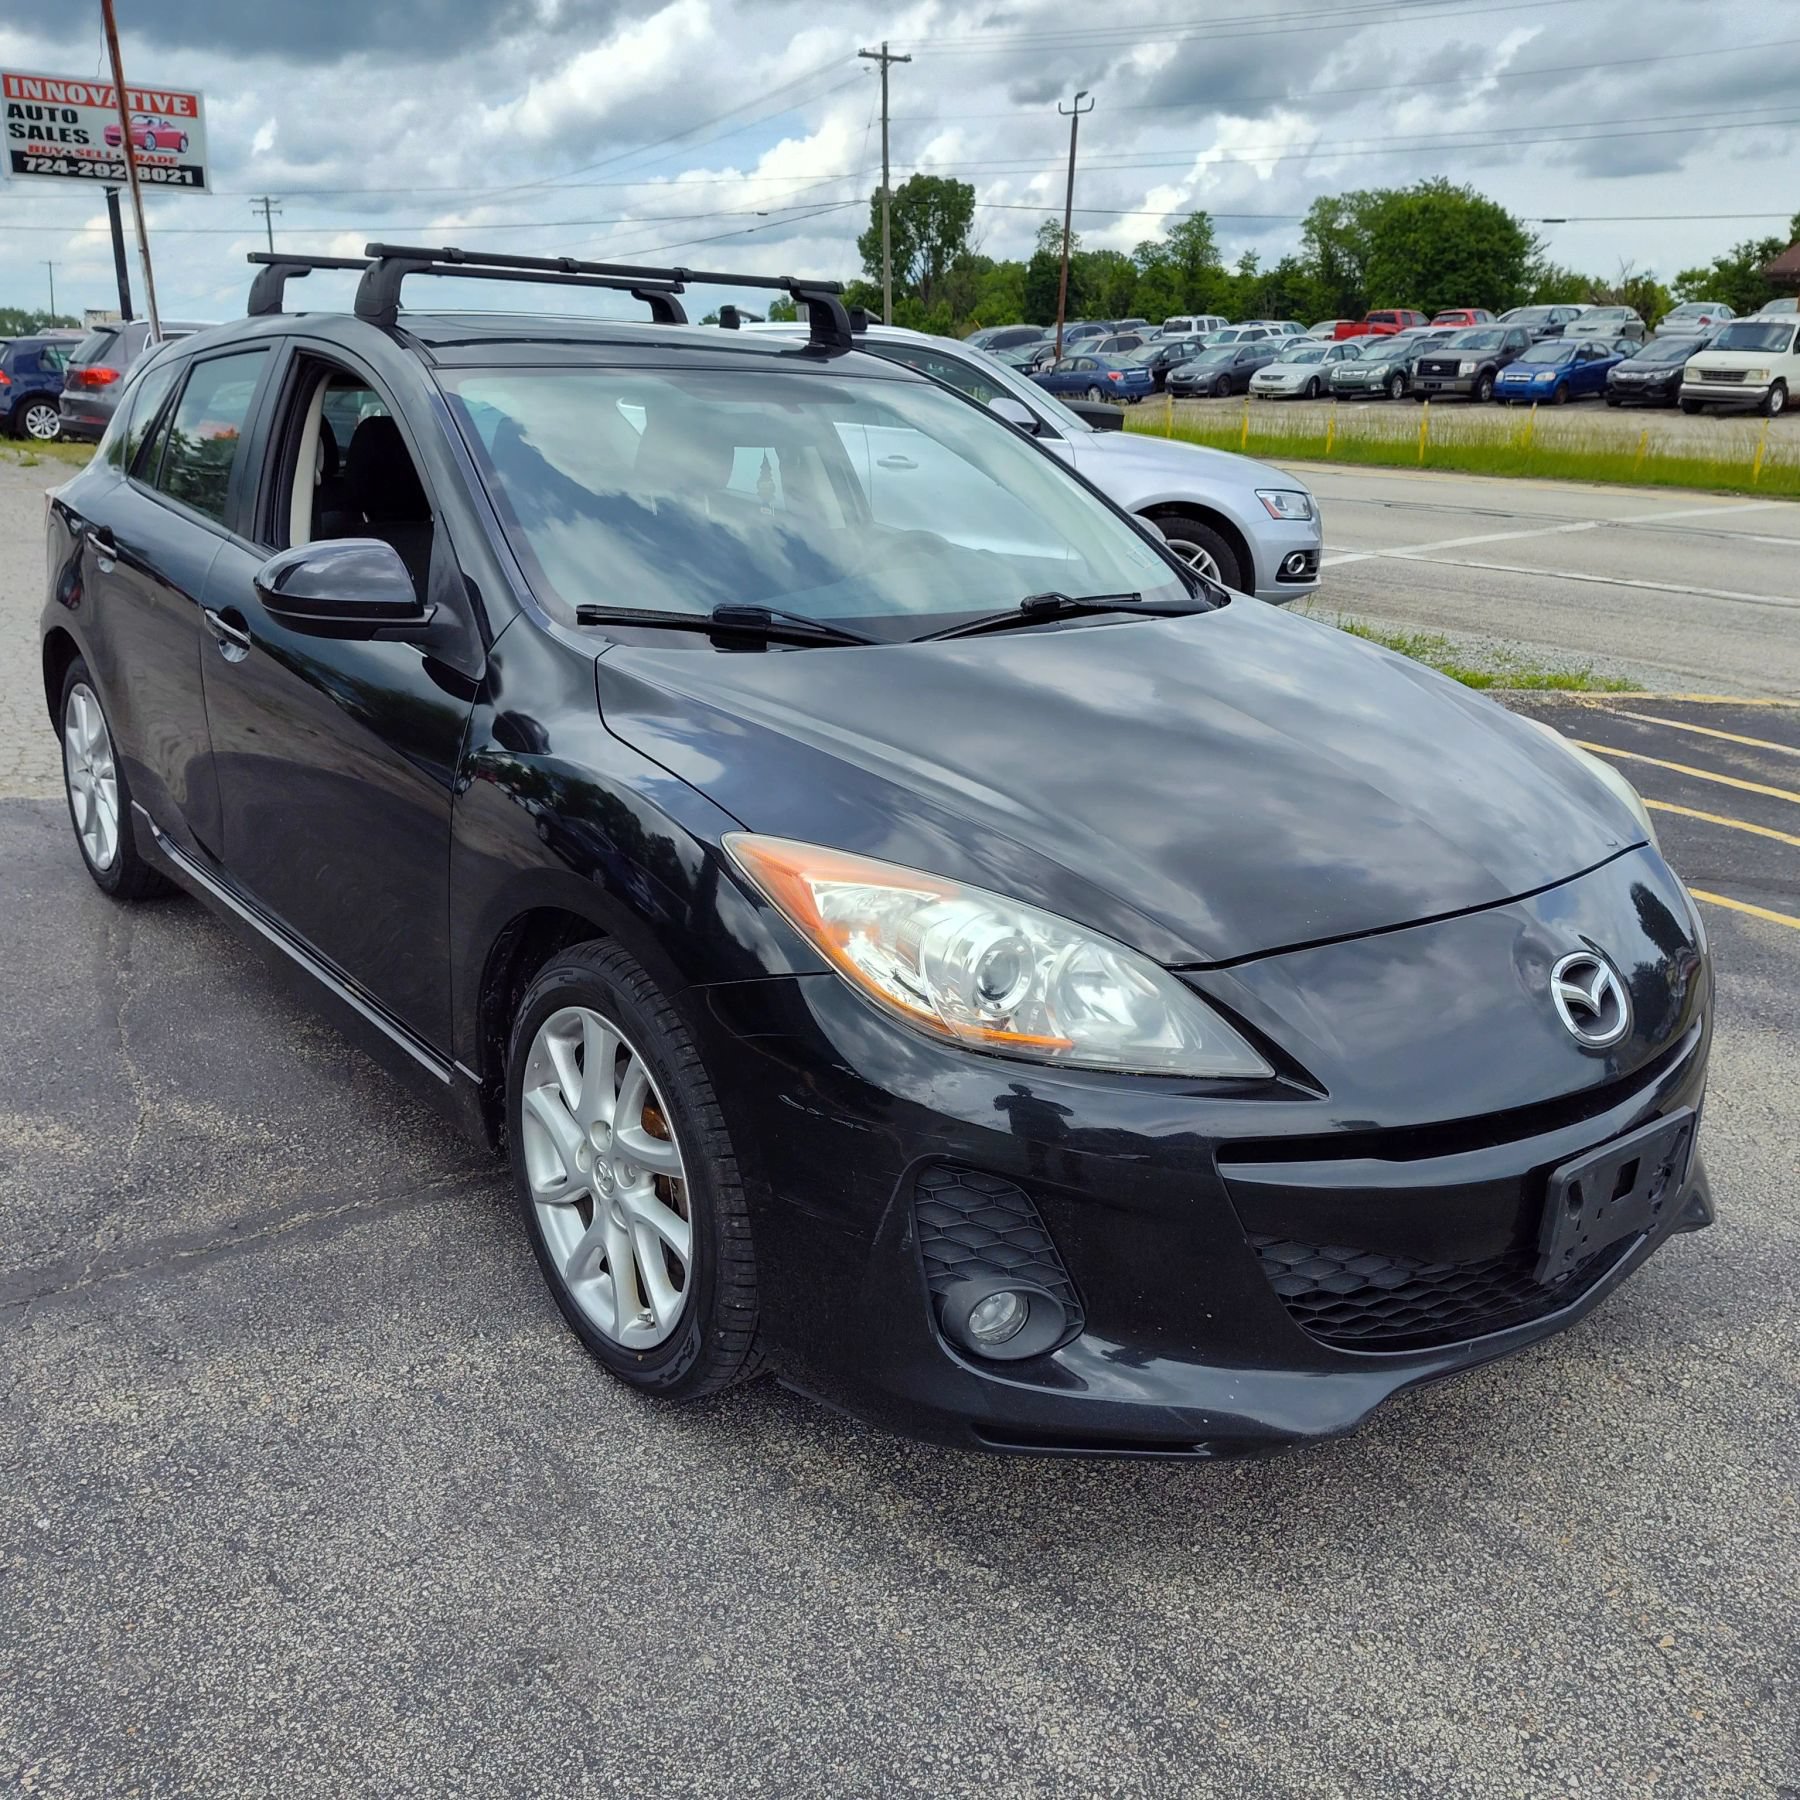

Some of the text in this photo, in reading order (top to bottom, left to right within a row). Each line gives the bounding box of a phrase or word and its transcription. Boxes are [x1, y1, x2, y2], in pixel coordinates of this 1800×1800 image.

[8, 103, 78, 124] AUTO
[8, 123, 90, 144] SALES
[28, 144, 179, 166] BUY SELL RADE
[24, 156, 194, 184] 724-2928021
